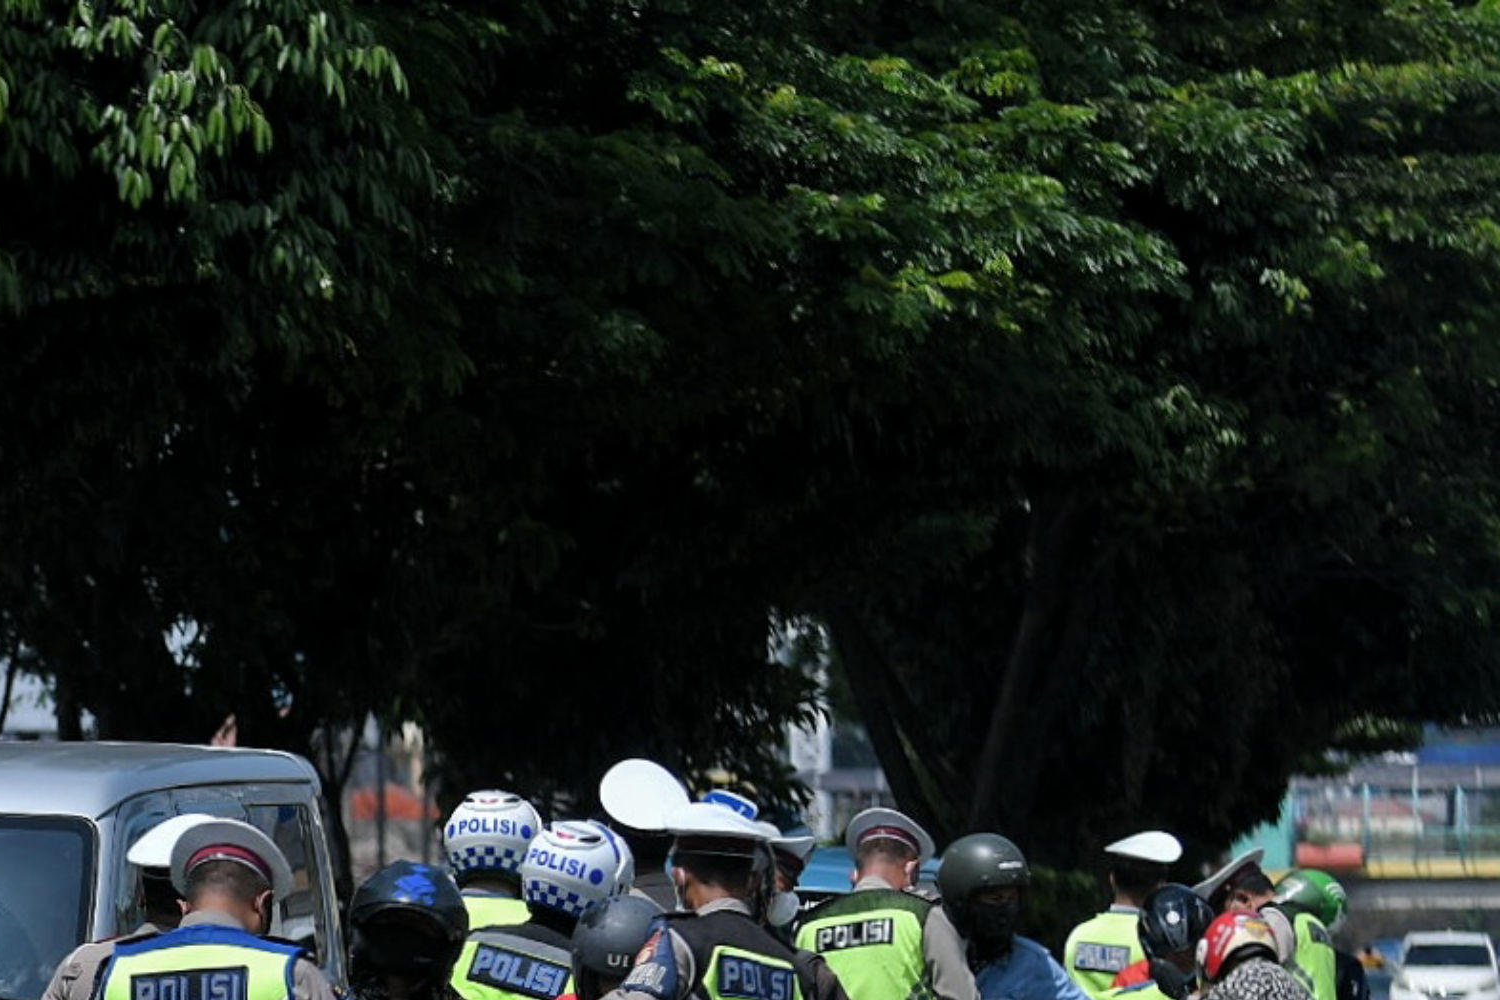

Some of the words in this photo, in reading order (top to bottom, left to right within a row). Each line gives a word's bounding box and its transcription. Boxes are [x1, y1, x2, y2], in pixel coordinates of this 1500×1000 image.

[459, 816, 517, 836] POLISI
[818, 917, 890, 951] POLISI
[473, 946, 568, 997] POLISI
